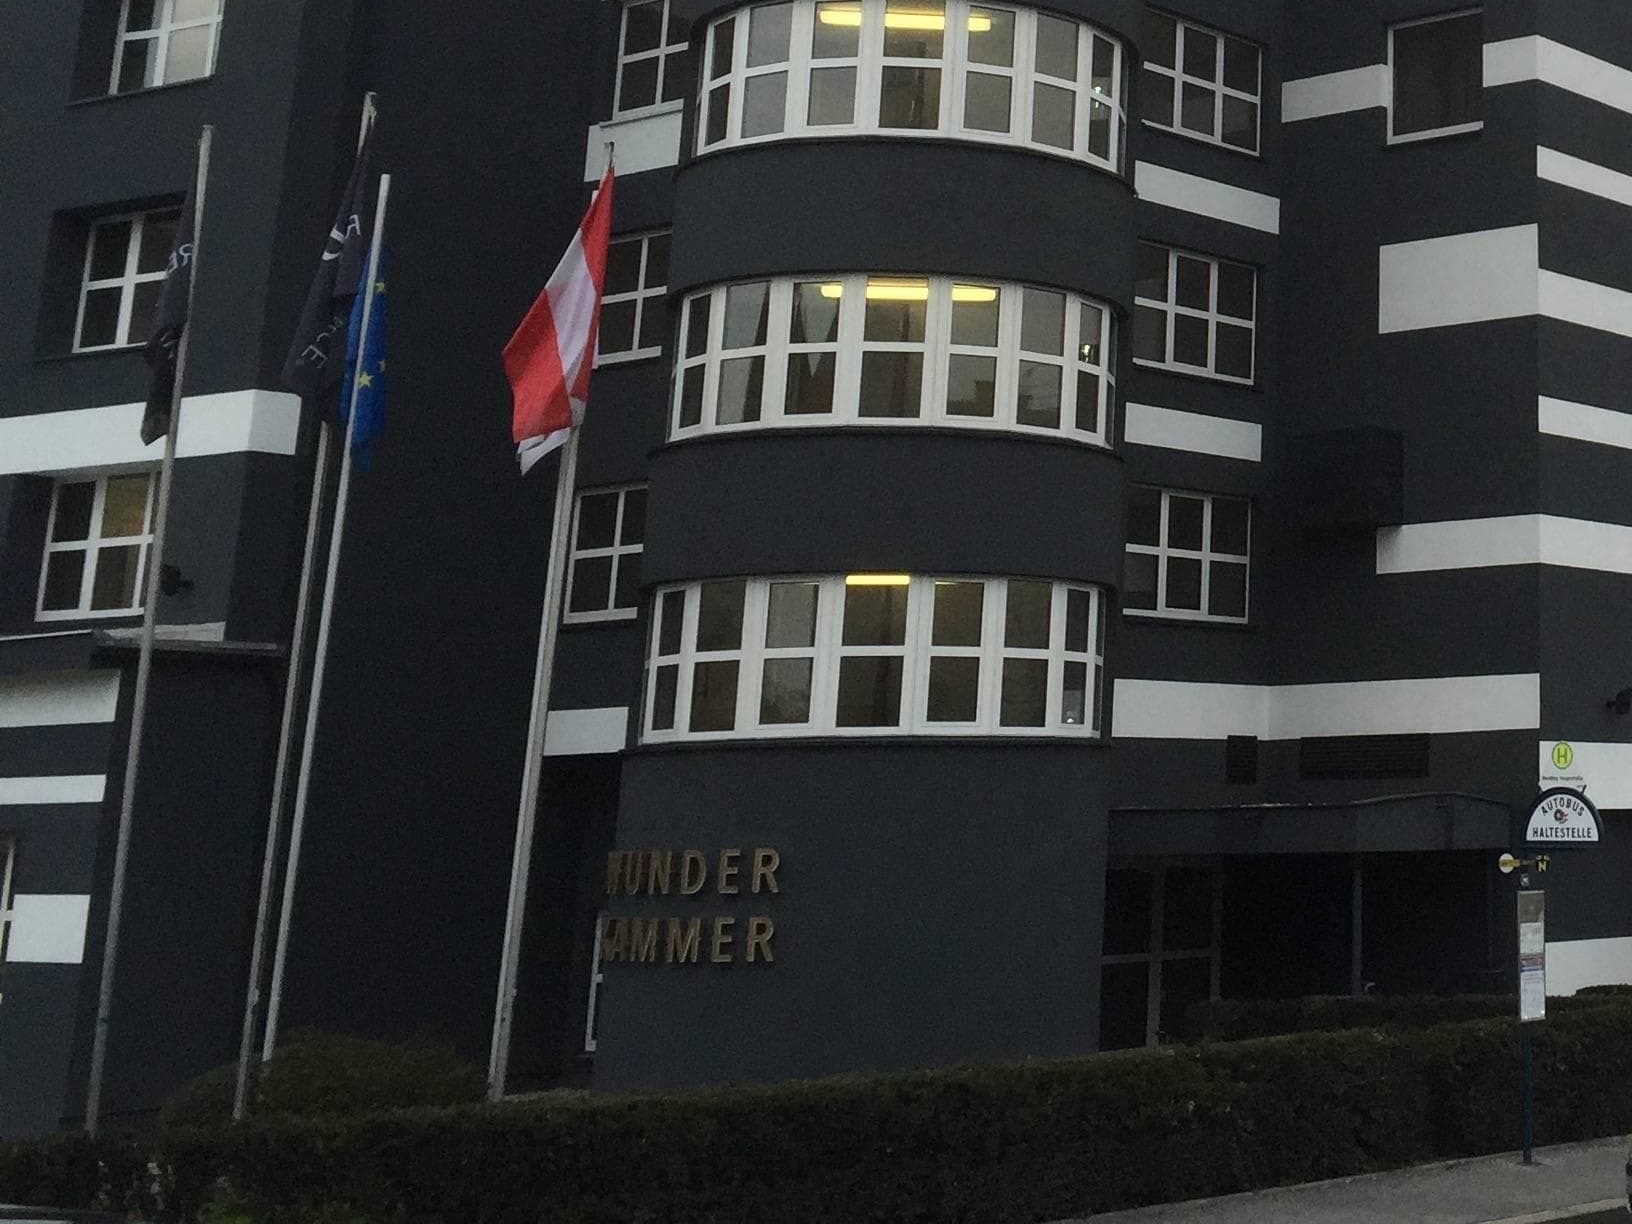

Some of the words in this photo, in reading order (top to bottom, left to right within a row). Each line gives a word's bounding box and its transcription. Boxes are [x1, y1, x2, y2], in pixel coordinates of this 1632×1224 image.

[1557, 747, 1568, 764] H
[1541, 797, 1584, 816] AUTOBUS
[1533, 827, 1592, 838] HALTESTELLE
